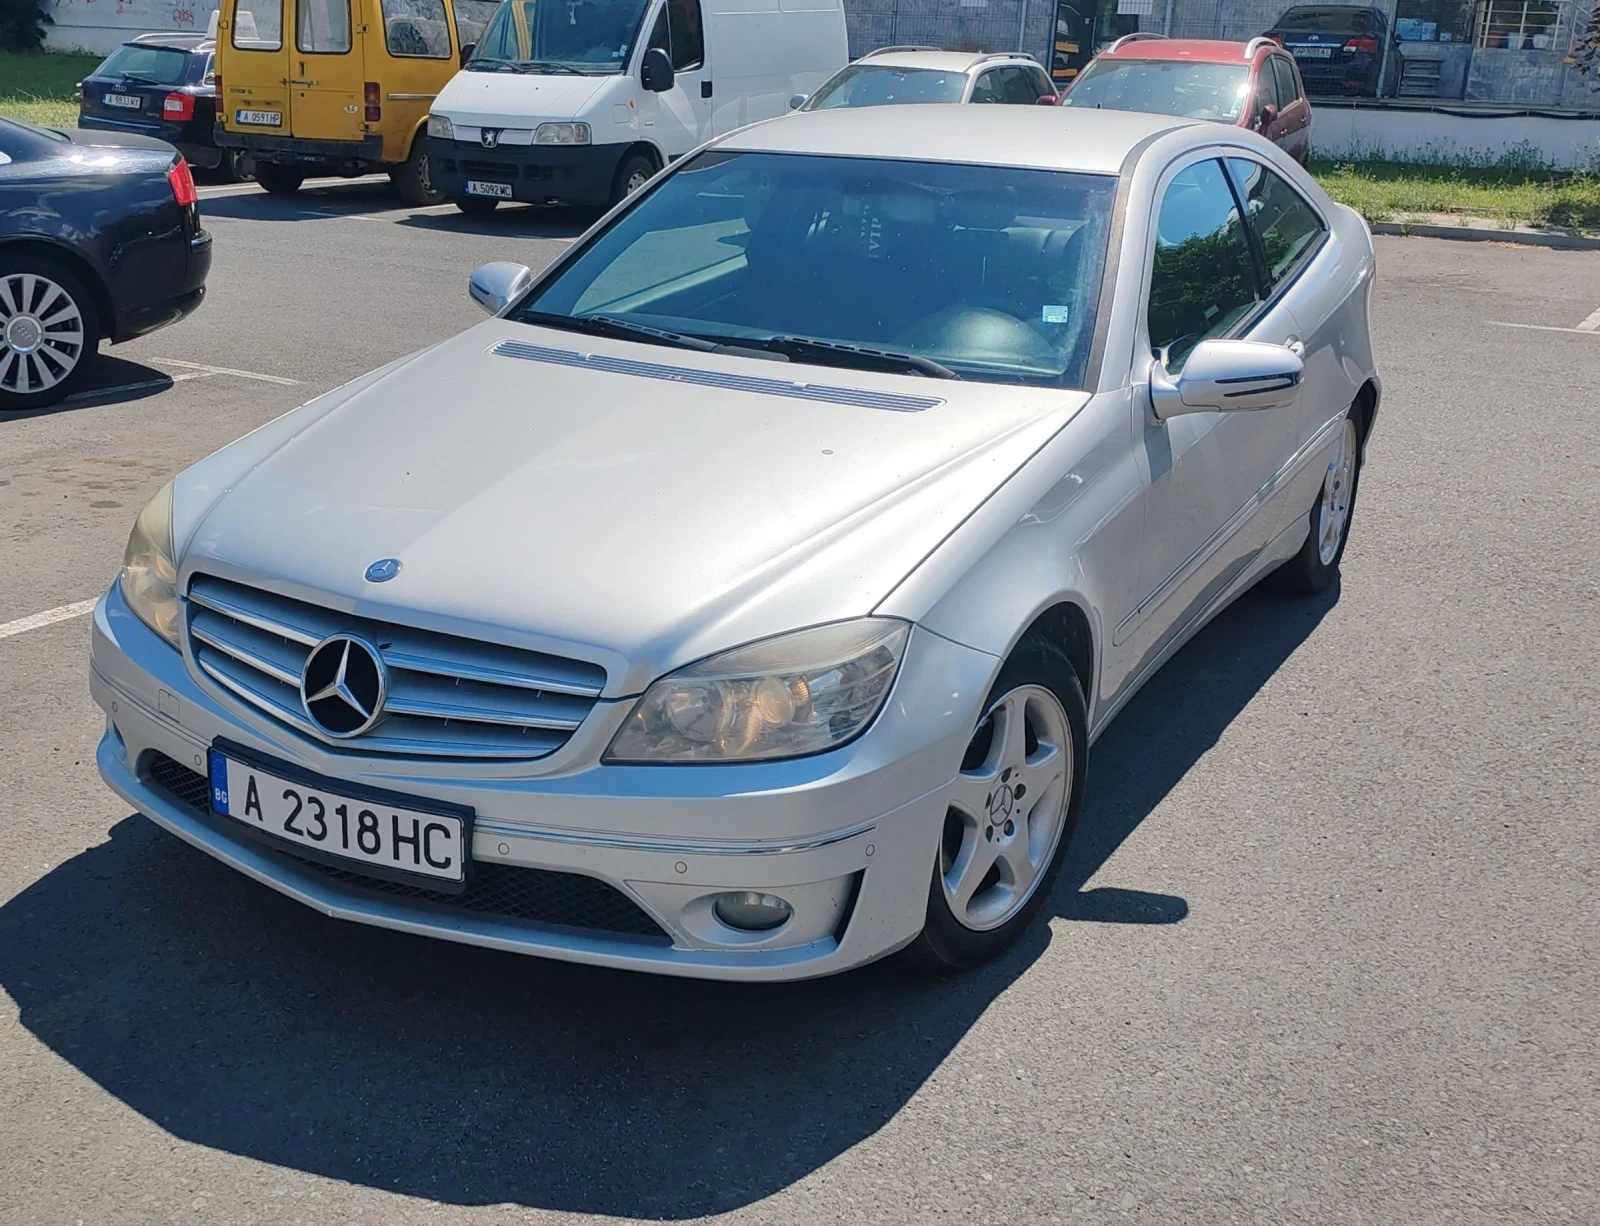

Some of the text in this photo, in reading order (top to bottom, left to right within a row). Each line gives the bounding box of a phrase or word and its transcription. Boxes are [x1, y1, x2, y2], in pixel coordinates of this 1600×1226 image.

[243, 112, 249, 121] A
[472, 182, 478, 193] A
[214, 787, 228, 804] BG
[244, 774, 264, 822] A
